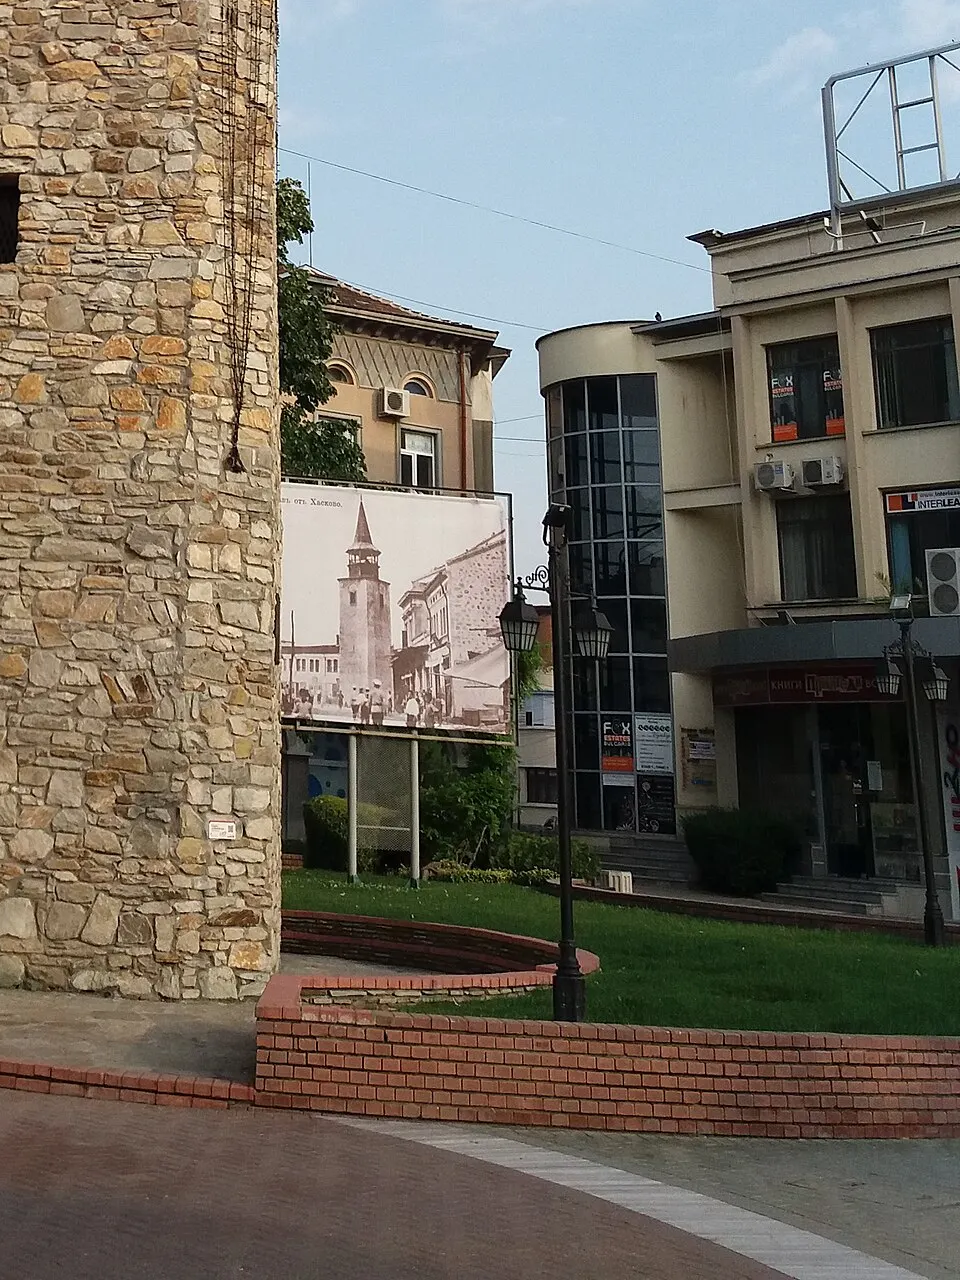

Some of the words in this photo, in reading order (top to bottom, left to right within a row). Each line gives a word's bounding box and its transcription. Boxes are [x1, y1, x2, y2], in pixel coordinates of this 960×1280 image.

[310, 498, 343, 508] Хасково.
[771, 679, 802, 690] КНИГИ
[604, 734, 631, 742] ESTATES
